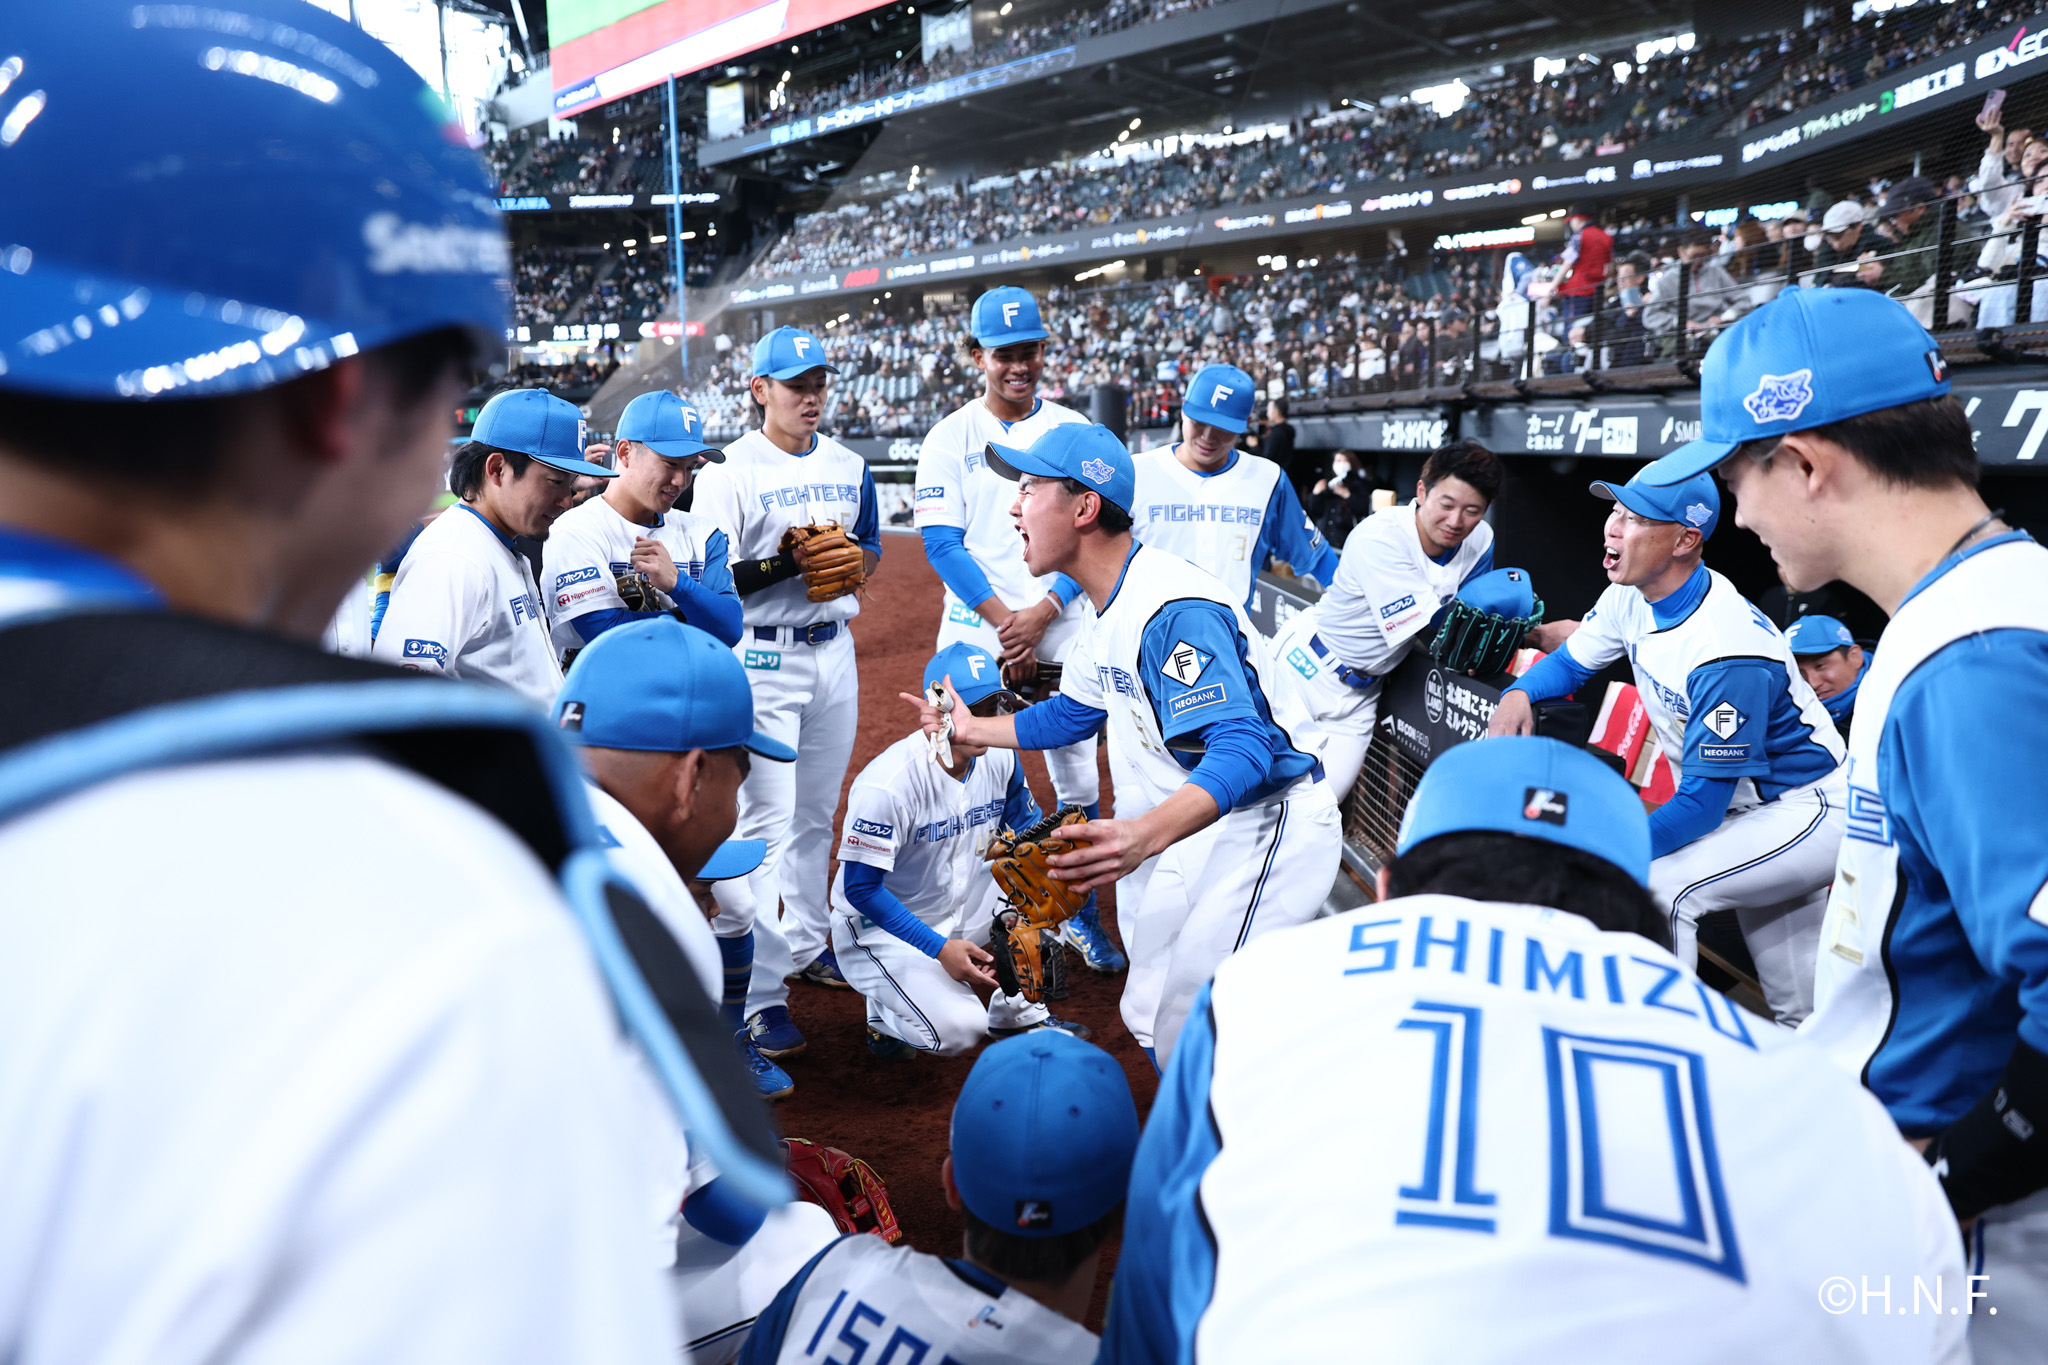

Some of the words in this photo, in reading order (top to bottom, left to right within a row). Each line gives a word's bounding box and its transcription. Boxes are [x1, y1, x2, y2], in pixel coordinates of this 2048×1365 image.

[1002, 302, 1021, 327] F
[792, 337, 811, 359] F
[1210, 384, 1234, 407] F
[680, 406, 698, 433] F
[760, 484, 858, 512] FIGHTERS
[1149, 504, 1262, 526] FIGHTERS
[564, 568, 597, 582] ホクレン
[571, 585, 606, 600] Nipponham
[747, 653, 779, 668] ニトリ
[967, 655, 986, 680] F
[1174, 649, 1194, 680] F
[1174, 690, 1217, 711] NEOBANK
[1715, 710, 1735, 734] F
[1704, 749, 1745, 758] NEOBANK
[862, 822, 892, 837] ホクレン
[914, 798, 1006, 845] FIGHTERS
[860, 841, 891, 853] Nipponham
[1343, 916, 1760, 1052] SHIMIZU
[1395, 999, 1749, 1287] 10
